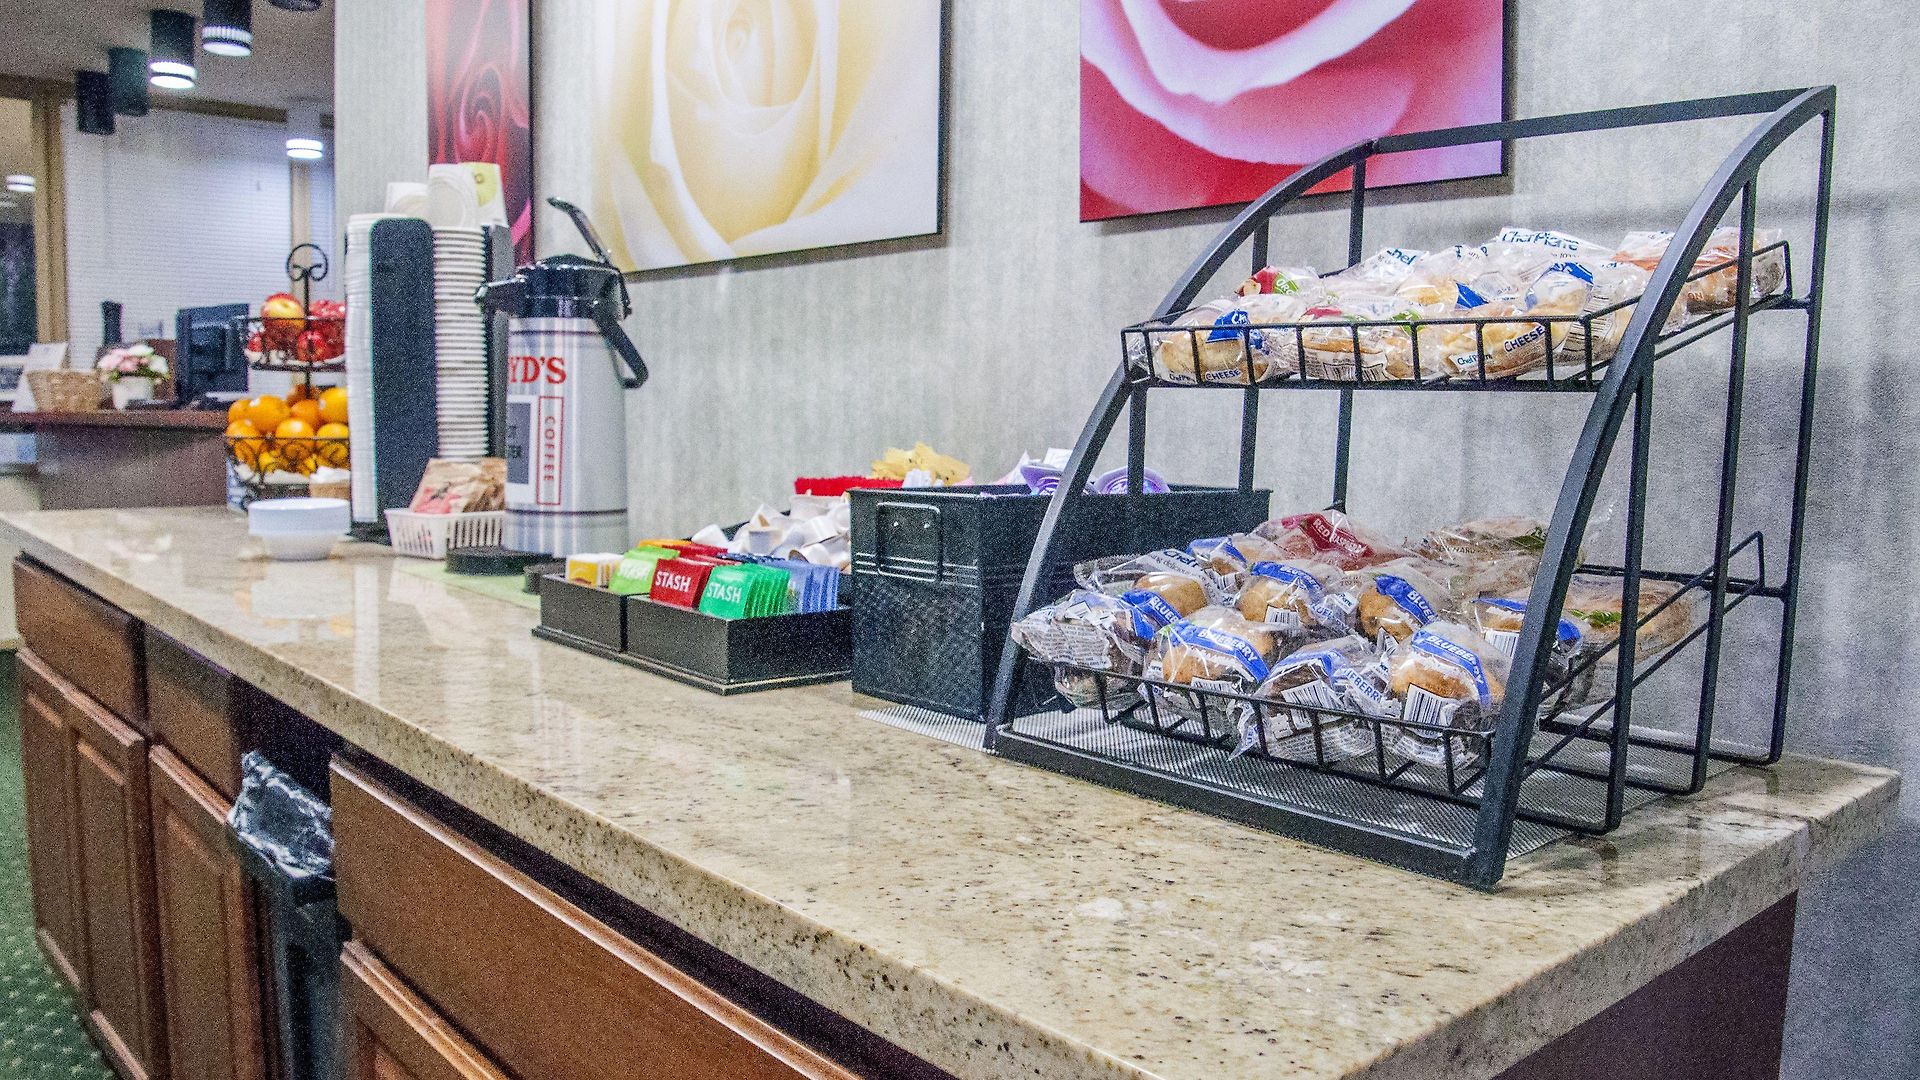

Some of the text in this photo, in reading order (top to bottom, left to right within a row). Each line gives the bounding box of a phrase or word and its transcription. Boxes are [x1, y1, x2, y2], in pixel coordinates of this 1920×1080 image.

[1504, 325, 1546, 353] CHEESE
[1205, 368, 1241, 382] CHEESE
[544, 415, 556, 481] COFFEE
[1312, 518, 1331, 538] RED
[655, 571, 692, 593] STASH
[706, 582, 743, 604] STASH
[1197, 628, 1258, 662] BUEBERRY
[1427, 635, 1485, 684] BLUEBERRY
